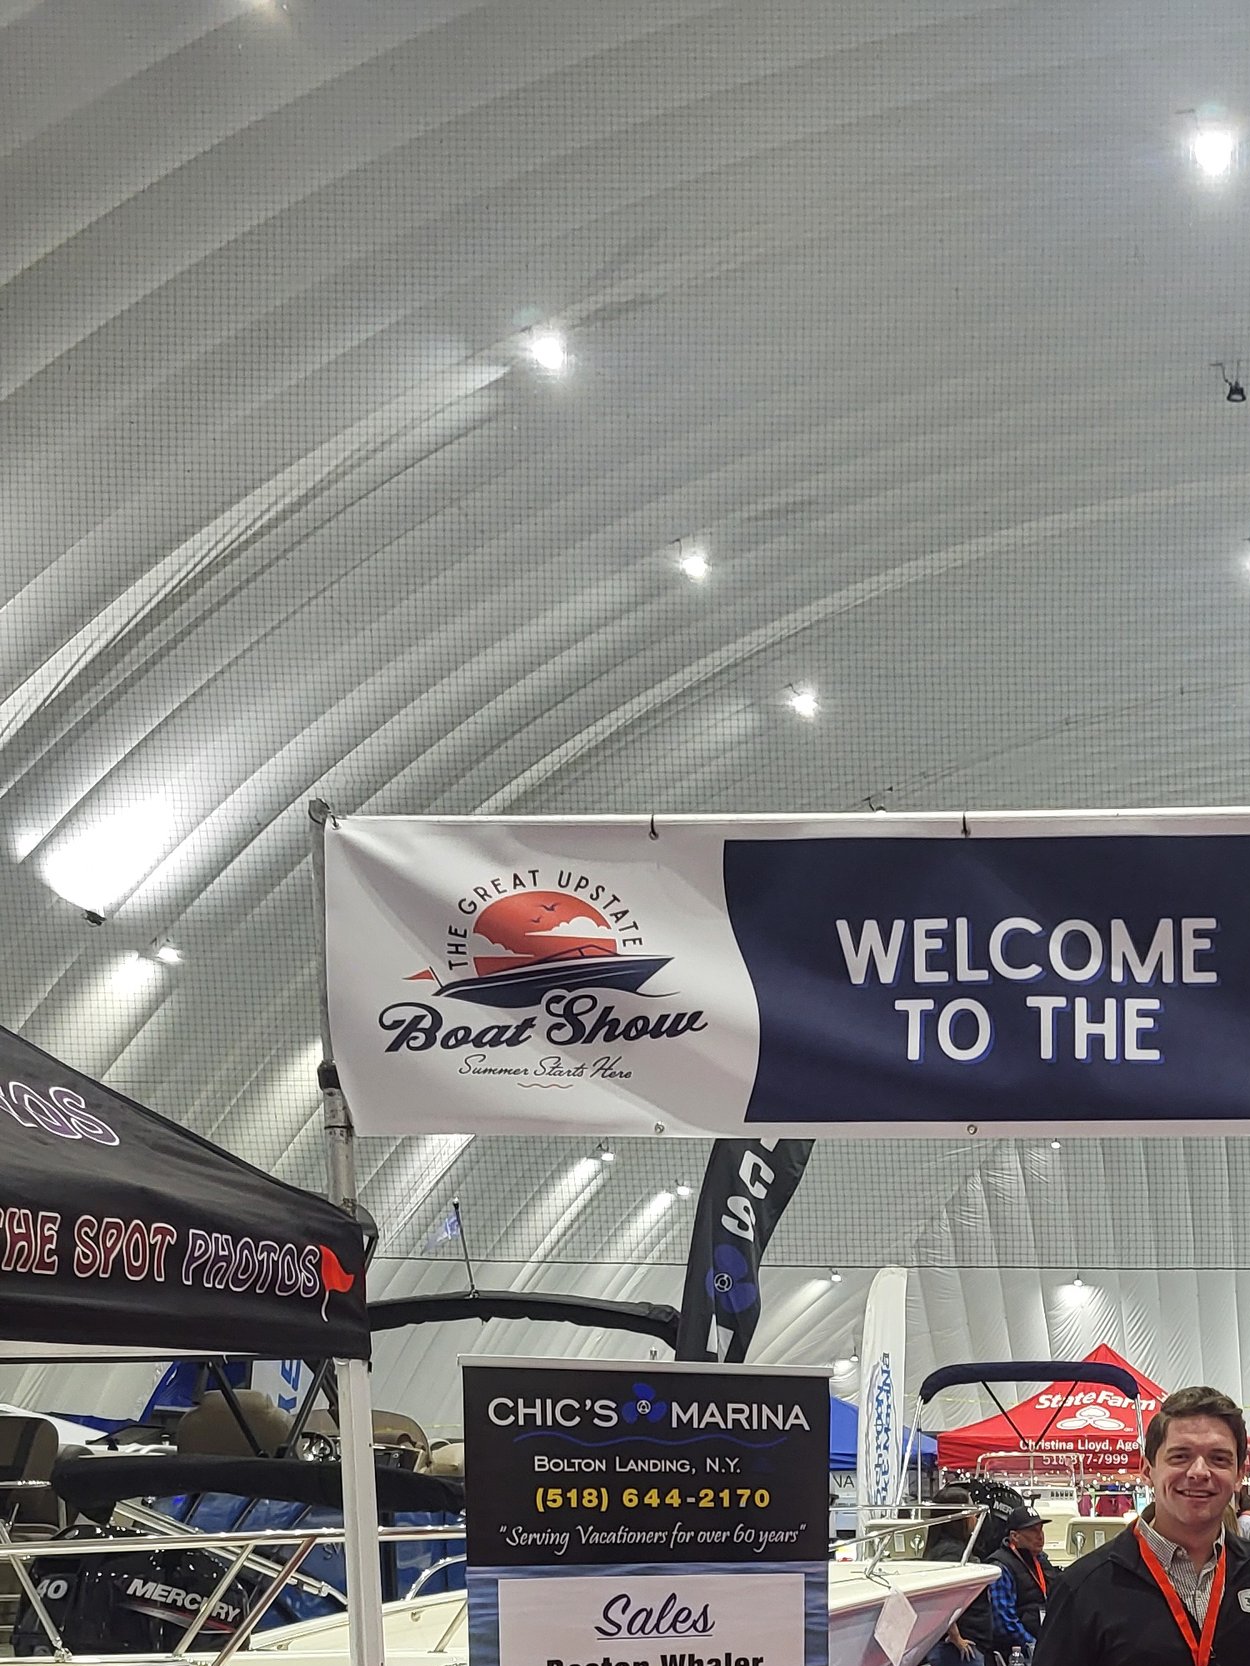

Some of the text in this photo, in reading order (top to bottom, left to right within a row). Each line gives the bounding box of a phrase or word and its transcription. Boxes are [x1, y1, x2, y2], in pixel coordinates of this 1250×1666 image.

[447, 870, 643, 970] THE GREAT UPSTATE
[836, 916, 1217, 986] WELCOME
[378, 990, 708, 1053] Boat Show
[905, 995, 1162, 1062] TO THE
[458, 1055, 632, 1079] Summer Starts Here
[0, 1207, 321, 1298] HE SPOT PHOTOS
[487, 1397, 811, 1431] CHIC'S MARINA
[1035, 1391, 1093, 1409] State
[1097, 1390, 1156, 1411] Farm
[1020, 1439, 1139, 1452] Christina Lloyd, Age
[534, 1455, 741, 1475] BOLTON LANDING, N.Y.
[535, 1488, 771, 1512] (518) 644-2170
[499, 1522, 807, 1555] "Serving Vacationers for over 60 years"
[594, 1592, 716, 1638] Sales
